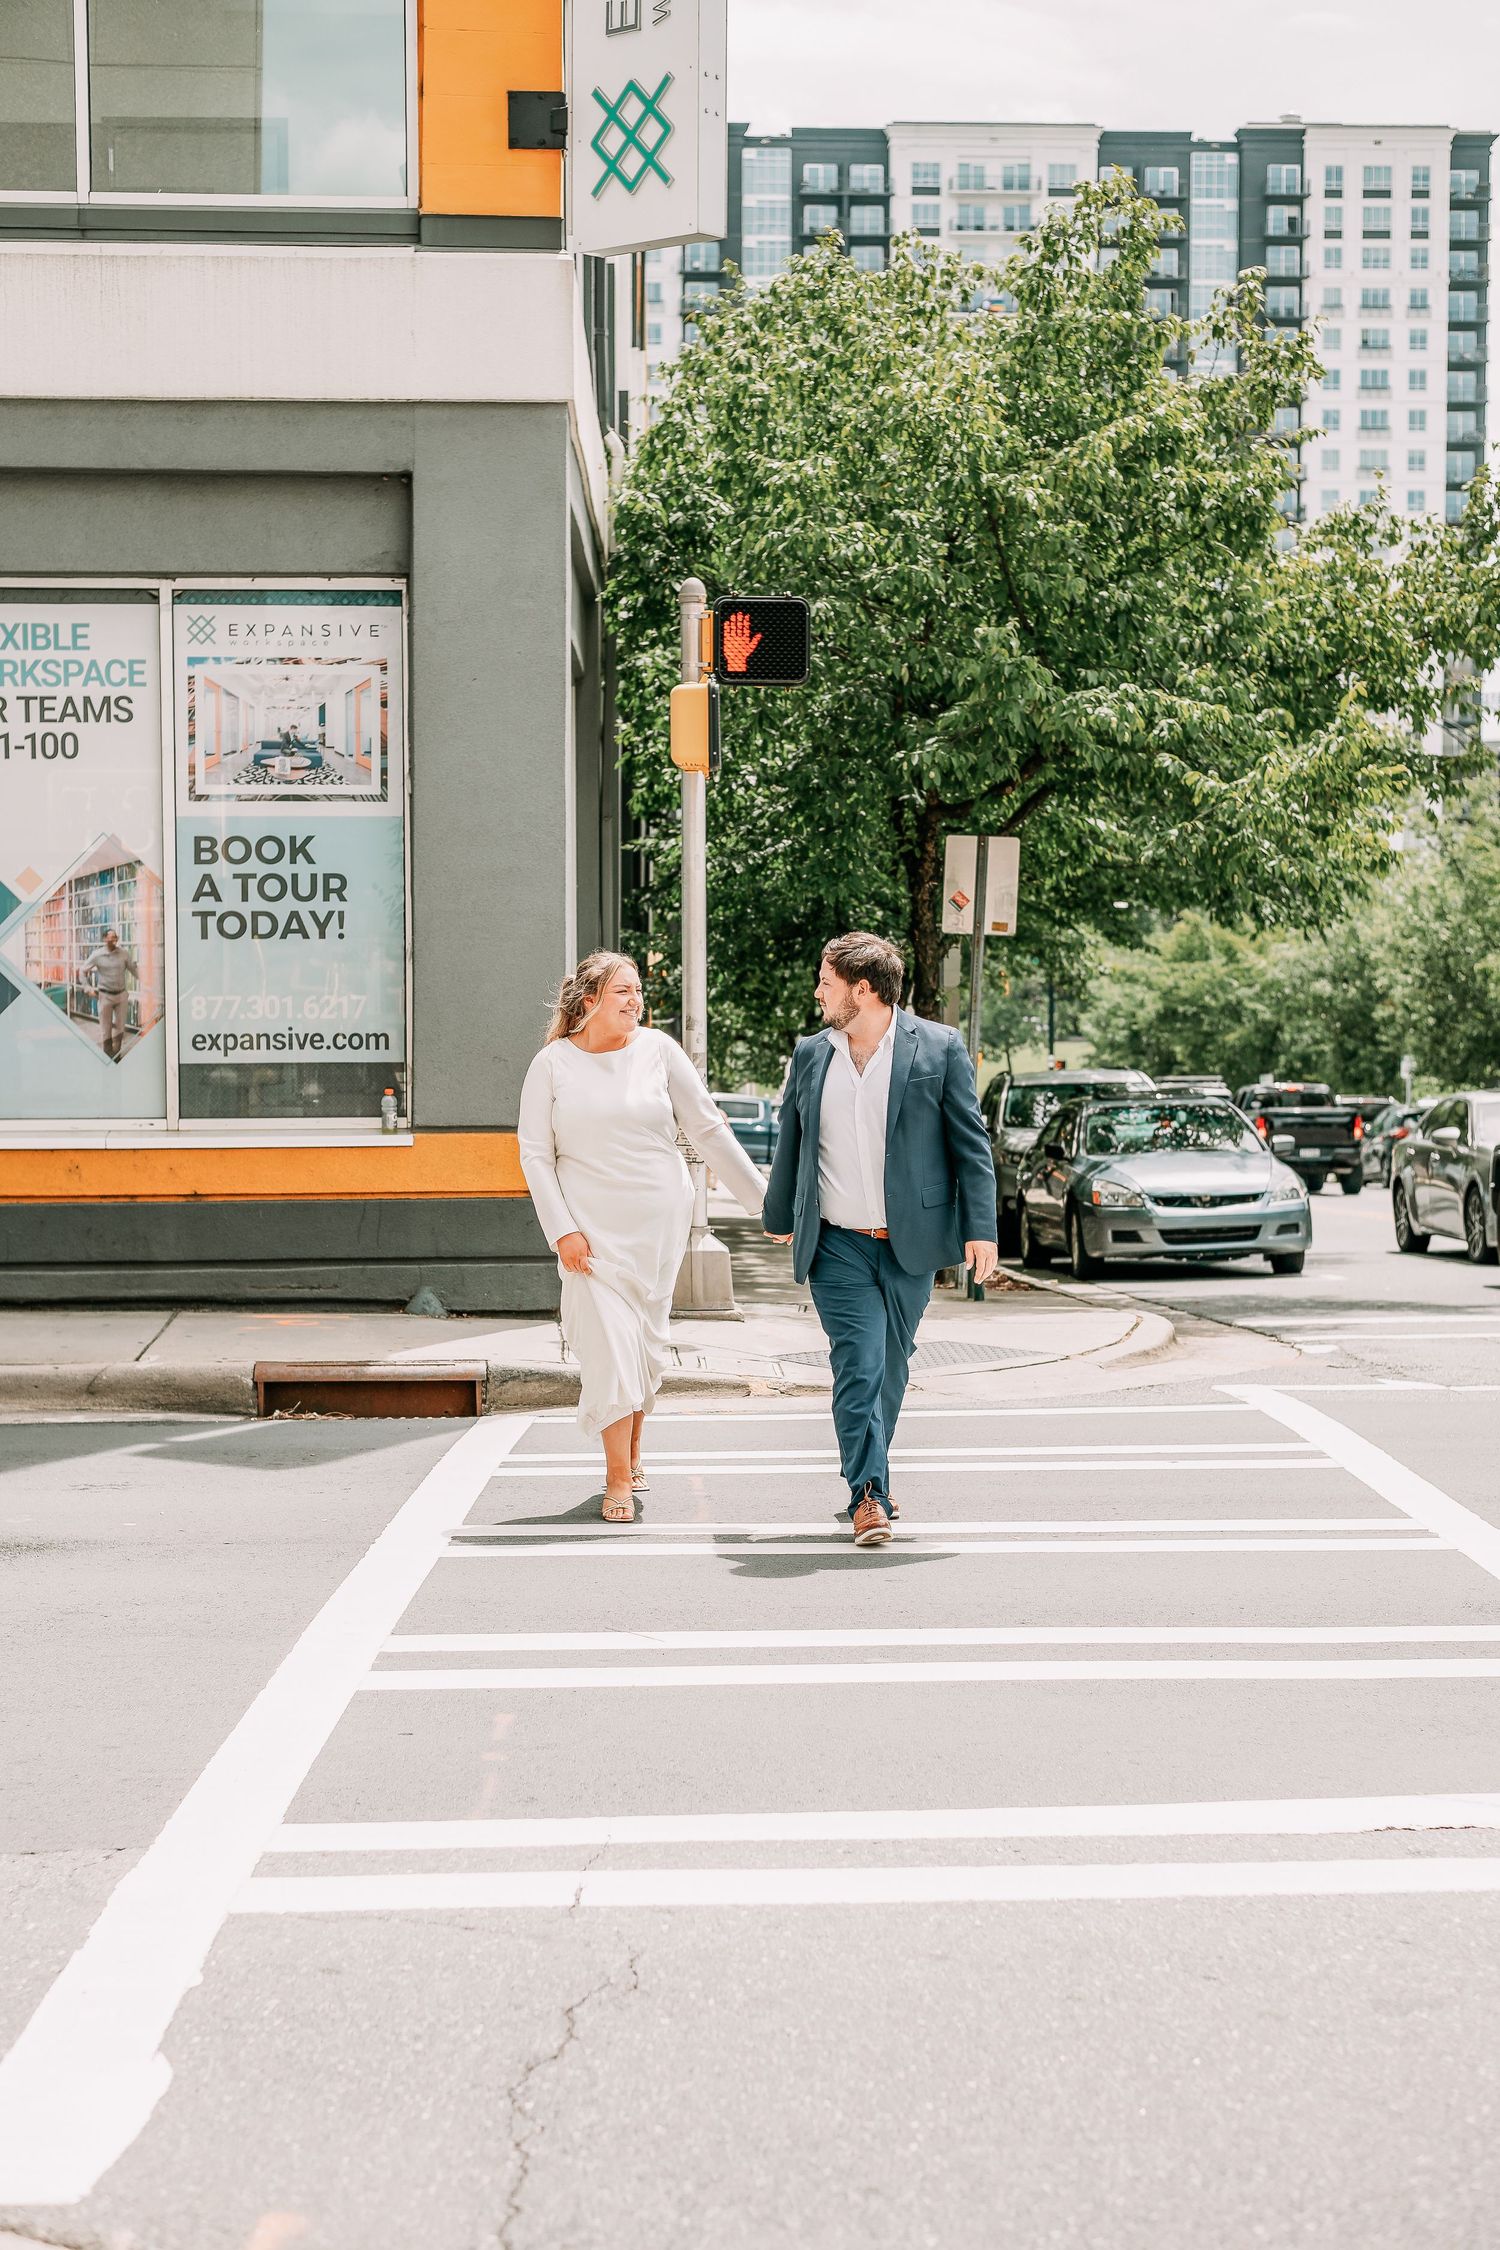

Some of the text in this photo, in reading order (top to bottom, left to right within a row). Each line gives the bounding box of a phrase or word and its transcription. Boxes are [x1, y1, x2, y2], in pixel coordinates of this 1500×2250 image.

[0, 622, 91, 651] XIBLE
[228, 623, 380, 638] EXPANSIVE
[229, 639, 329, 647] workspace
[0, 658, 147, 688] RKSPACE
[16, 695, 134, 724] TEAMS
[0, 731, 80, 760] 1-100
[193, 834, 317, 866] BOOK
[191, 872, 348, 903] A TOUR
[191, 910, 346, 941] TODAY!
[191, 994, 368, 1021] 877.301.6217
[191, 1026, 390, 1057] expansive.com
